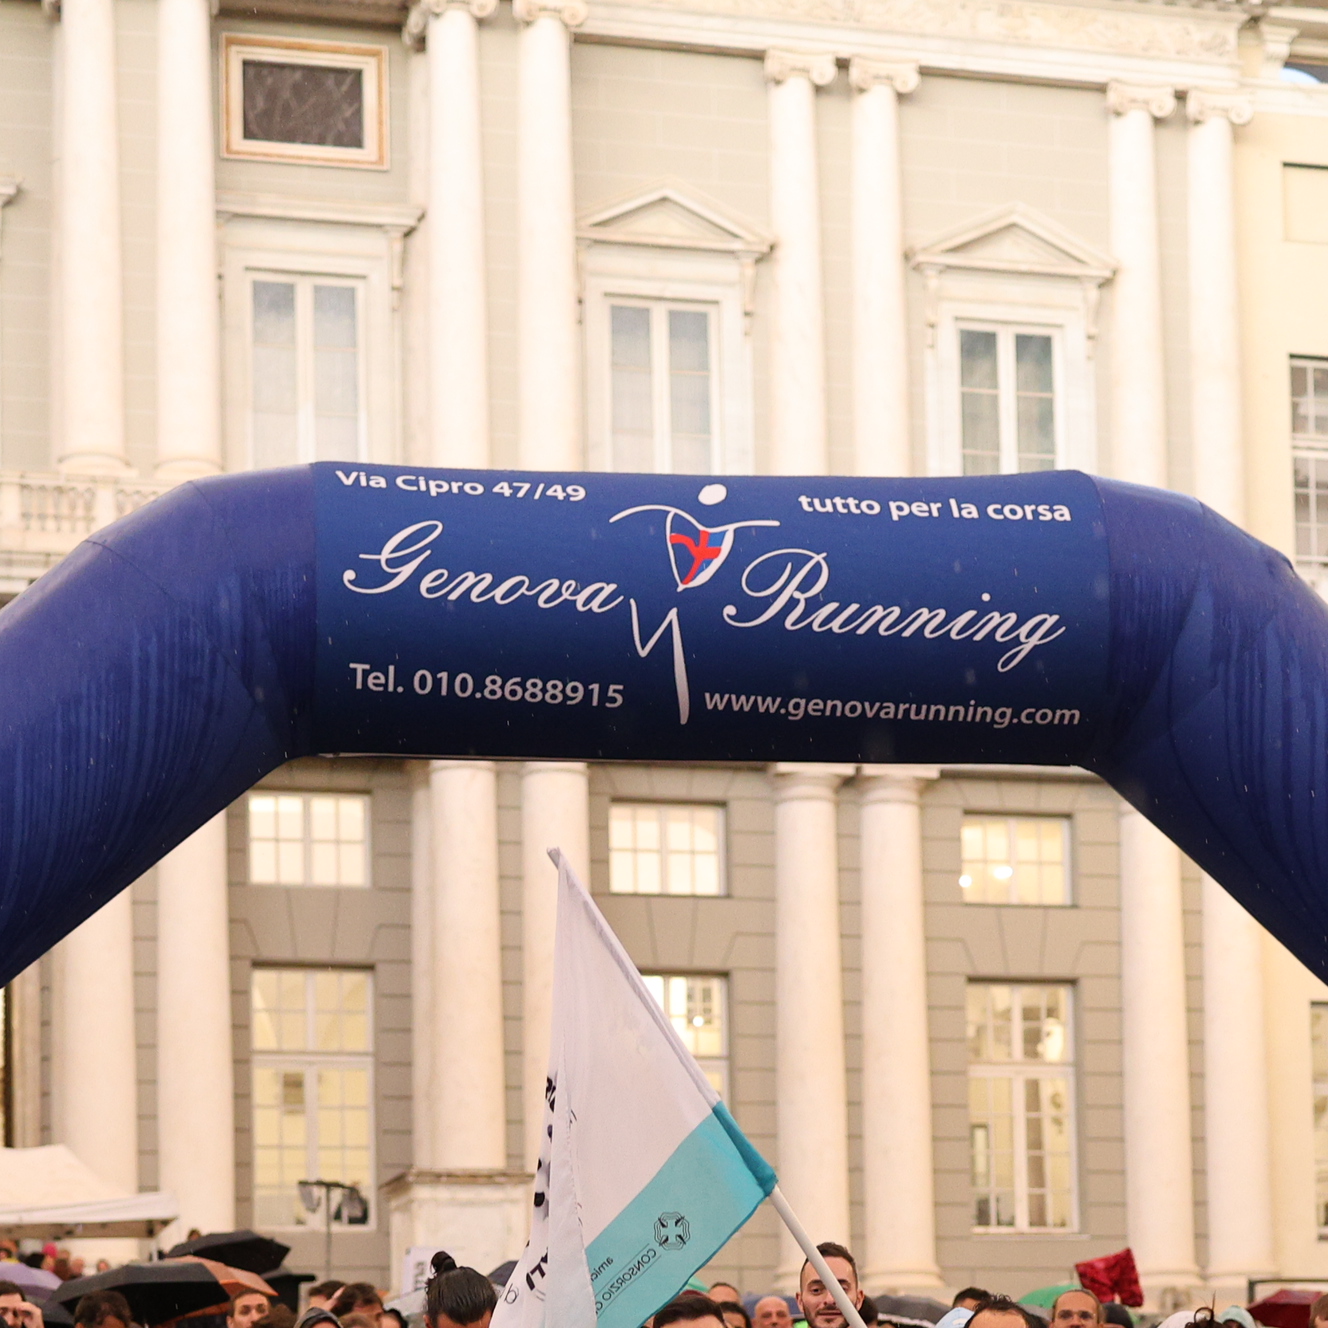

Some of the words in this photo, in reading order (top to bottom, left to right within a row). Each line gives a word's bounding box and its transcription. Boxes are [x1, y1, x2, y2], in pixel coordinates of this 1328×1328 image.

[335, 470, 387, 489] Via
[395, 475, 485, 497] Cipro
[492, 481, 586, 502] 47/49
[797, 494, 881, 515] tutto
[888, 500, 942, 522] per
[948, 497, 979, 519] la
[986, 503, 1072, 522] corsa
[343, 520, 624, 613] Genova
[723, 548, 1065, 672] Running
[349, 663, 404, 693] Tel.
[413, 669, 624, 708] 010.8688915
[704, 691, 1080, 728] www.genovarunning.com
